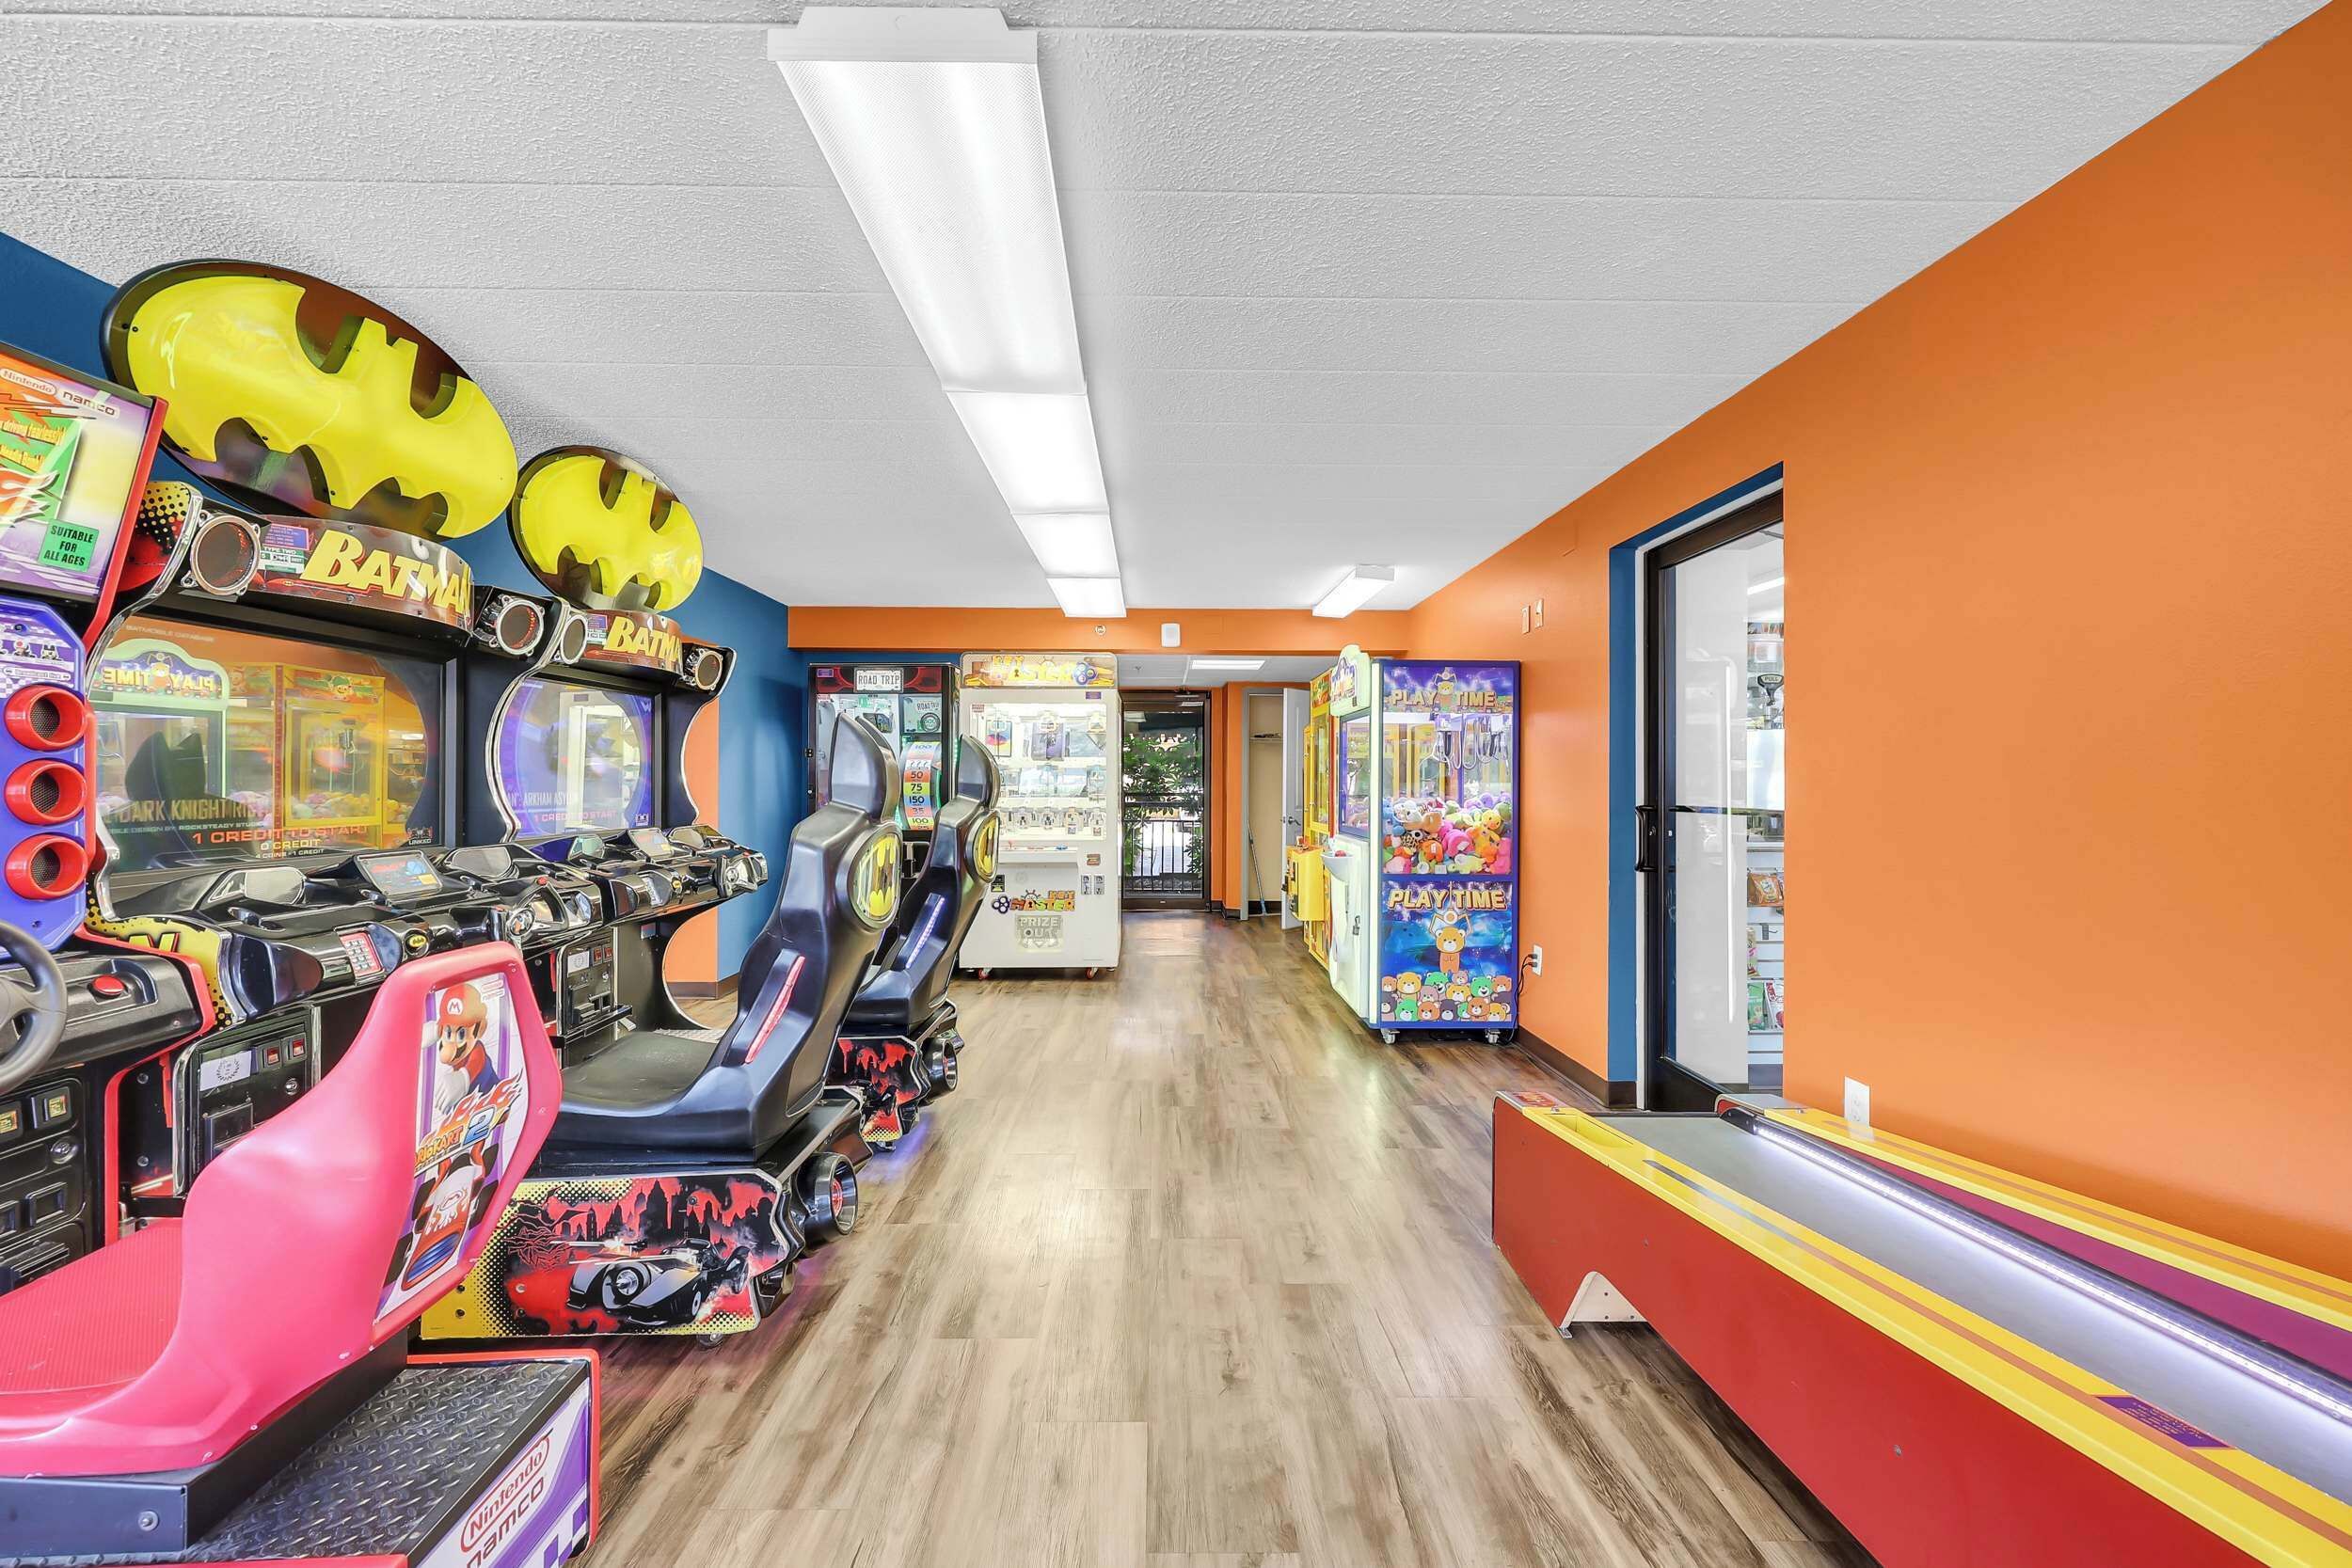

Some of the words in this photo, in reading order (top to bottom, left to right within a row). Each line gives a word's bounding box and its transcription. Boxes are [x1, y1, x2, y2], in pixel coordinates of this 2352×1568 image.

[4, 370, 53, 393] Nintendo
[50, 525, 93, 544] SUITABLE
[59, 540, 77, 553] FOR
[43, 549, 59, 561] ALL
[61, 552, 86, 566] AGES
[299, 529, 470, 615] BATMAN
[603, 616, 681, 662] BATMA
[857, 674, 878, 685] ROAD
[882, 674, 900, 685] TRIP
[1391, 690, 1438, 706] PLAY
[1458, 690, 1498, 707] TIME
[910, 770, 924, 780] 50
[911, 783, 923, 792] 75
[523, 790, 553, 807] ARKHAM
[909, 796, 925, 804] 150
[171, 798, 226, 821] KNIGHT
[179, 822, 234, 831] ROCKSTEADY
[192, 832, 203, 844] 1
[210, 829, 282, 844] CREDIT
[288, 827, 310, 839] TO
[314, 825, 369, 836] START
[273, 838, 322, 850] CREDIT
[1387, 889, 1450, 910] PLAY
[1452, 889, 1507, 911] TIME
[1019, 916, 1059, 927] PRIZE
[469, 1449, 543, 1540] Nintendo
[467, 1476, 545, 1568] namco
